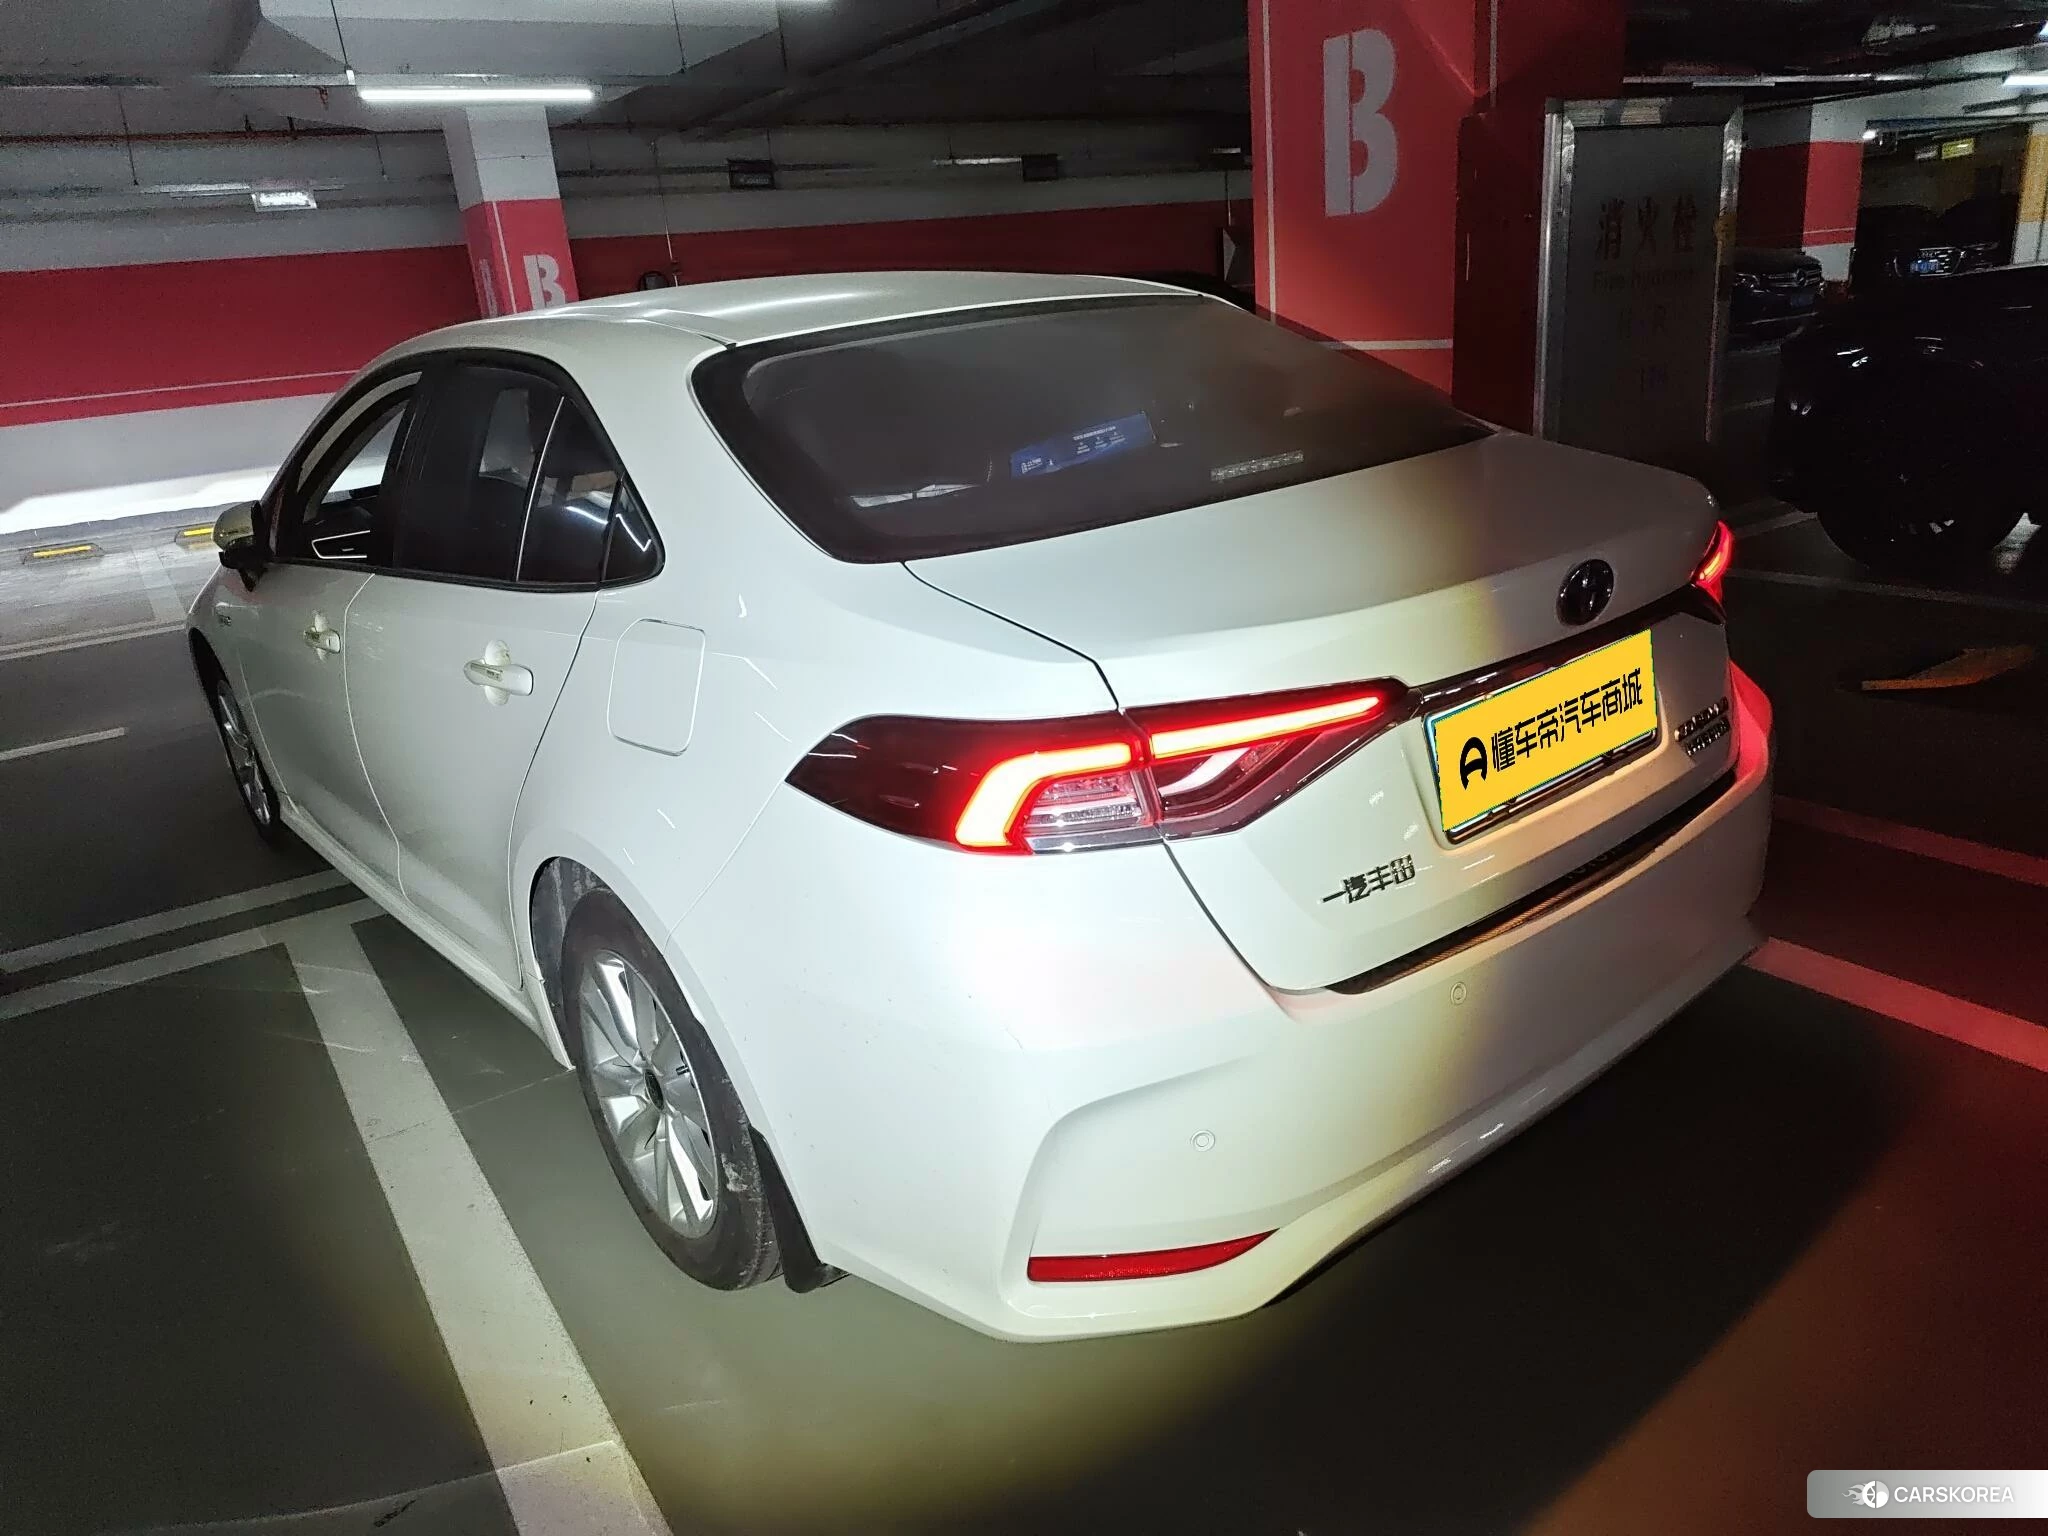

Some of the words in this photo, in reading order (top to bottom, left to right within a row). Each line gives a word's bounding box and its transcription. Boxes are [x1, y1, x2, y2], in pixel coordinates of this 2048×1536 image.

[1323, 28, 1399, 216] B
[1595, 194, 1698, 261] 消火栓
[523, 254, 566, 310] B
[1319, 854, 1417, 904] 一汽丰田
